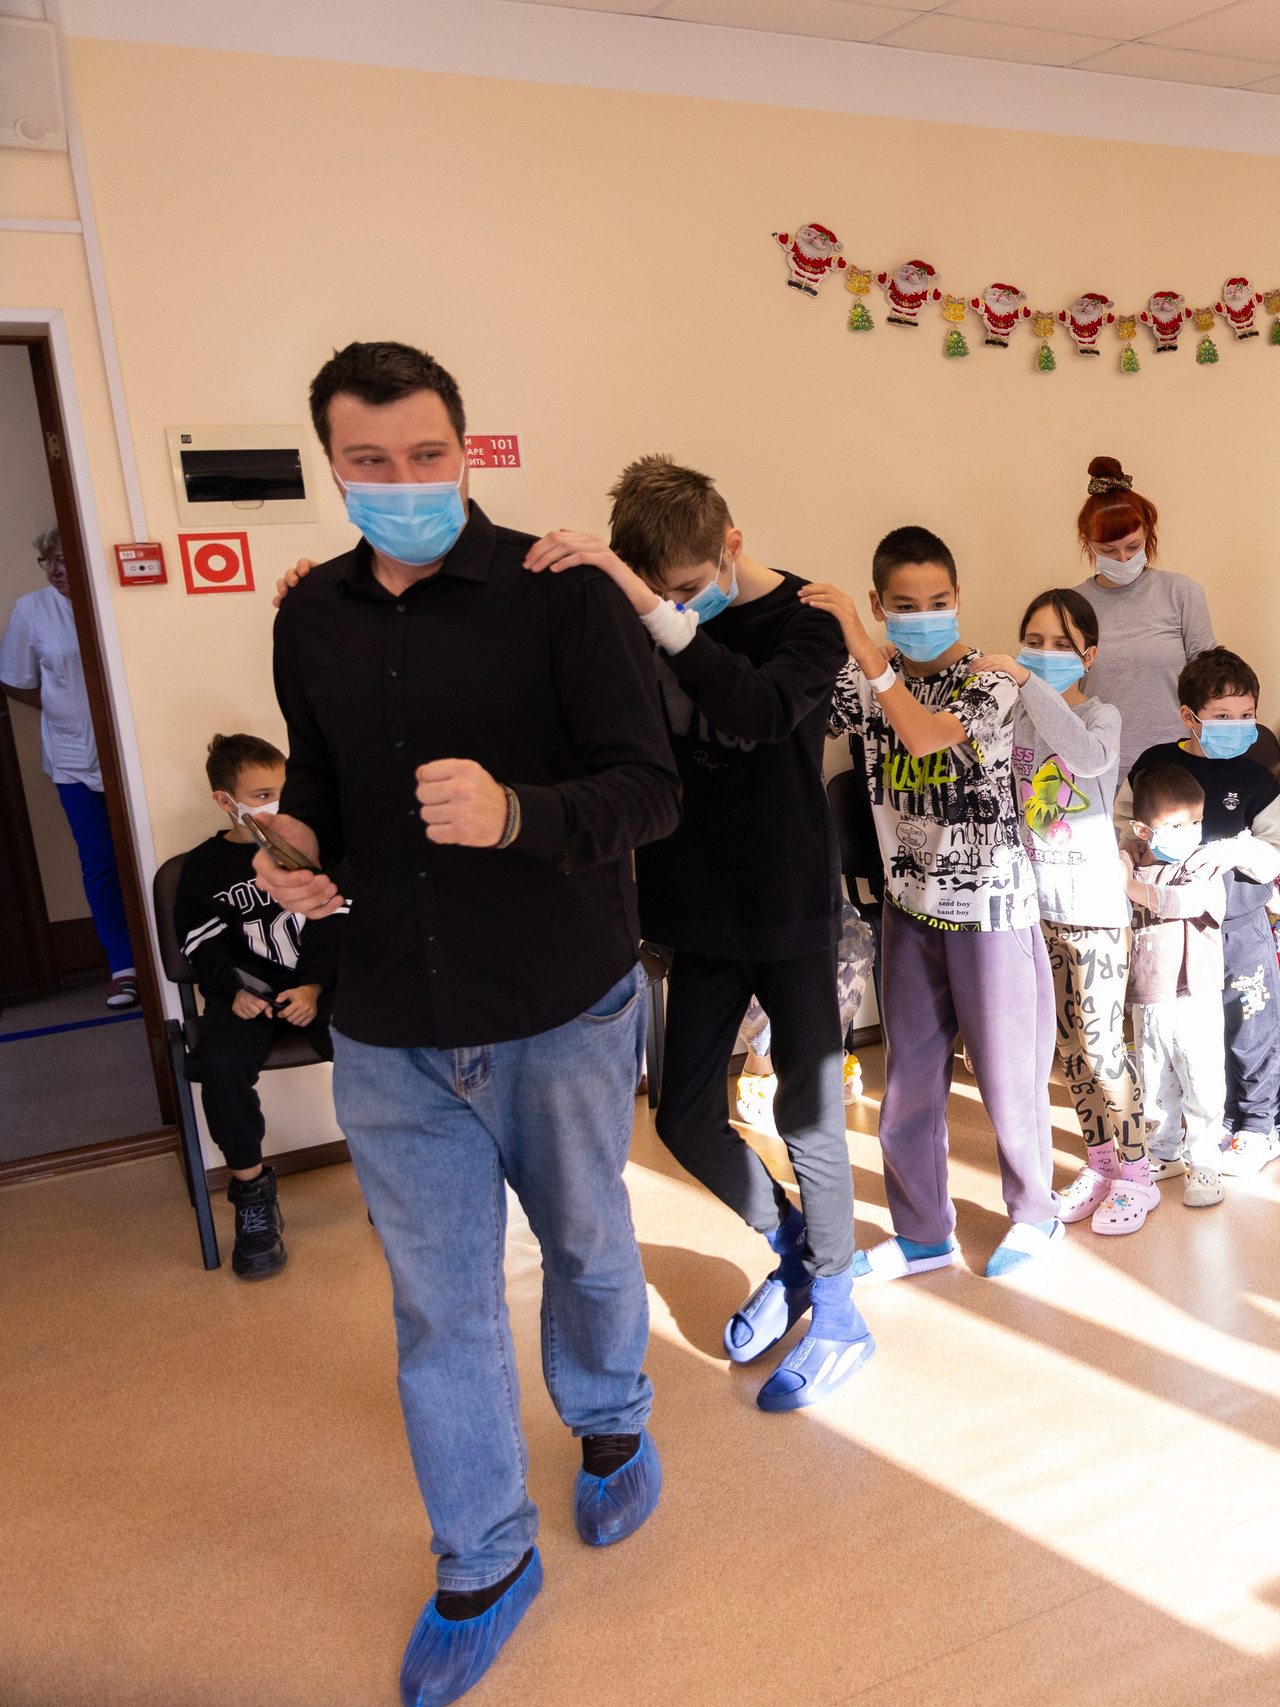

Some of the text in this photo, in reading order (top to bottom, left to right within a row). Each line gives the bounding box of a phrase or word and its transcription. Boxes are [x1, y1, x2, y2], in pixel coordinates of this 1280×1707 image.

[490, 439, 513, 450] 101
[467, 448, 485, 456] АРЕ
[469, 454, 516, 466] ИТЬ 112
[956, 901, 971, 909] boy
